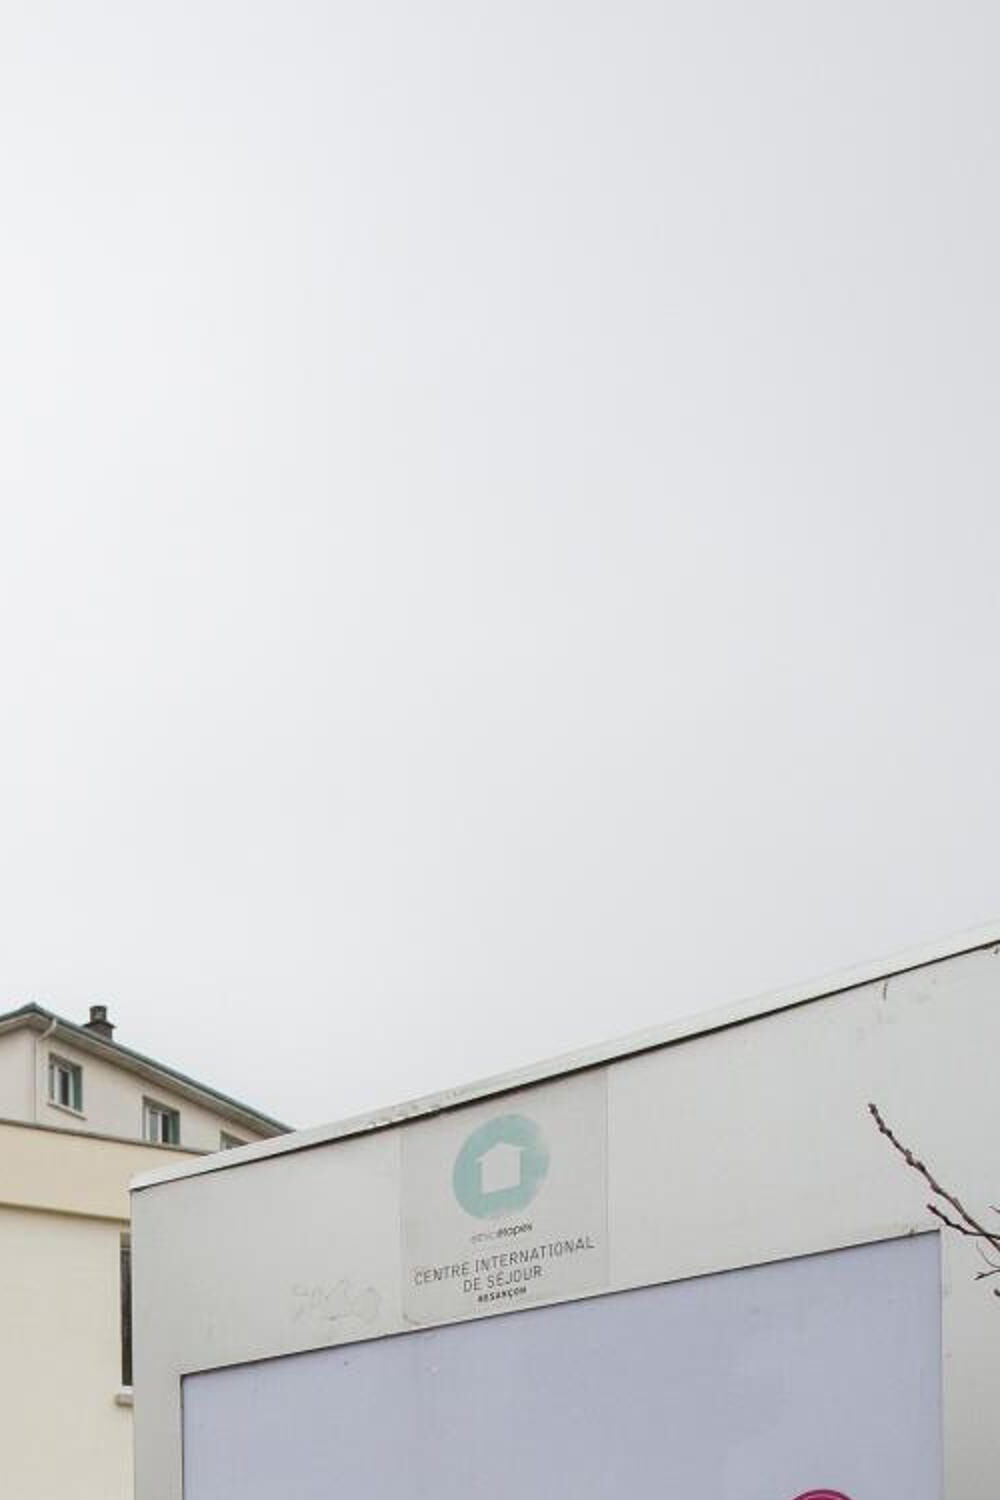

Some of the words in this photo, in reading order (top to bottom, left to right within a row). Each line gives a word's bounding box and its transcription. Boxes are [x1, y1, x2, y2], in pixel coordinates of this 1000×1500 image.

[414, 1262, 470, 1286] CENTRE
[475, 1236, 595, 1273] INTERNATIONAL
[463, 1278, 481, 1293] DE
